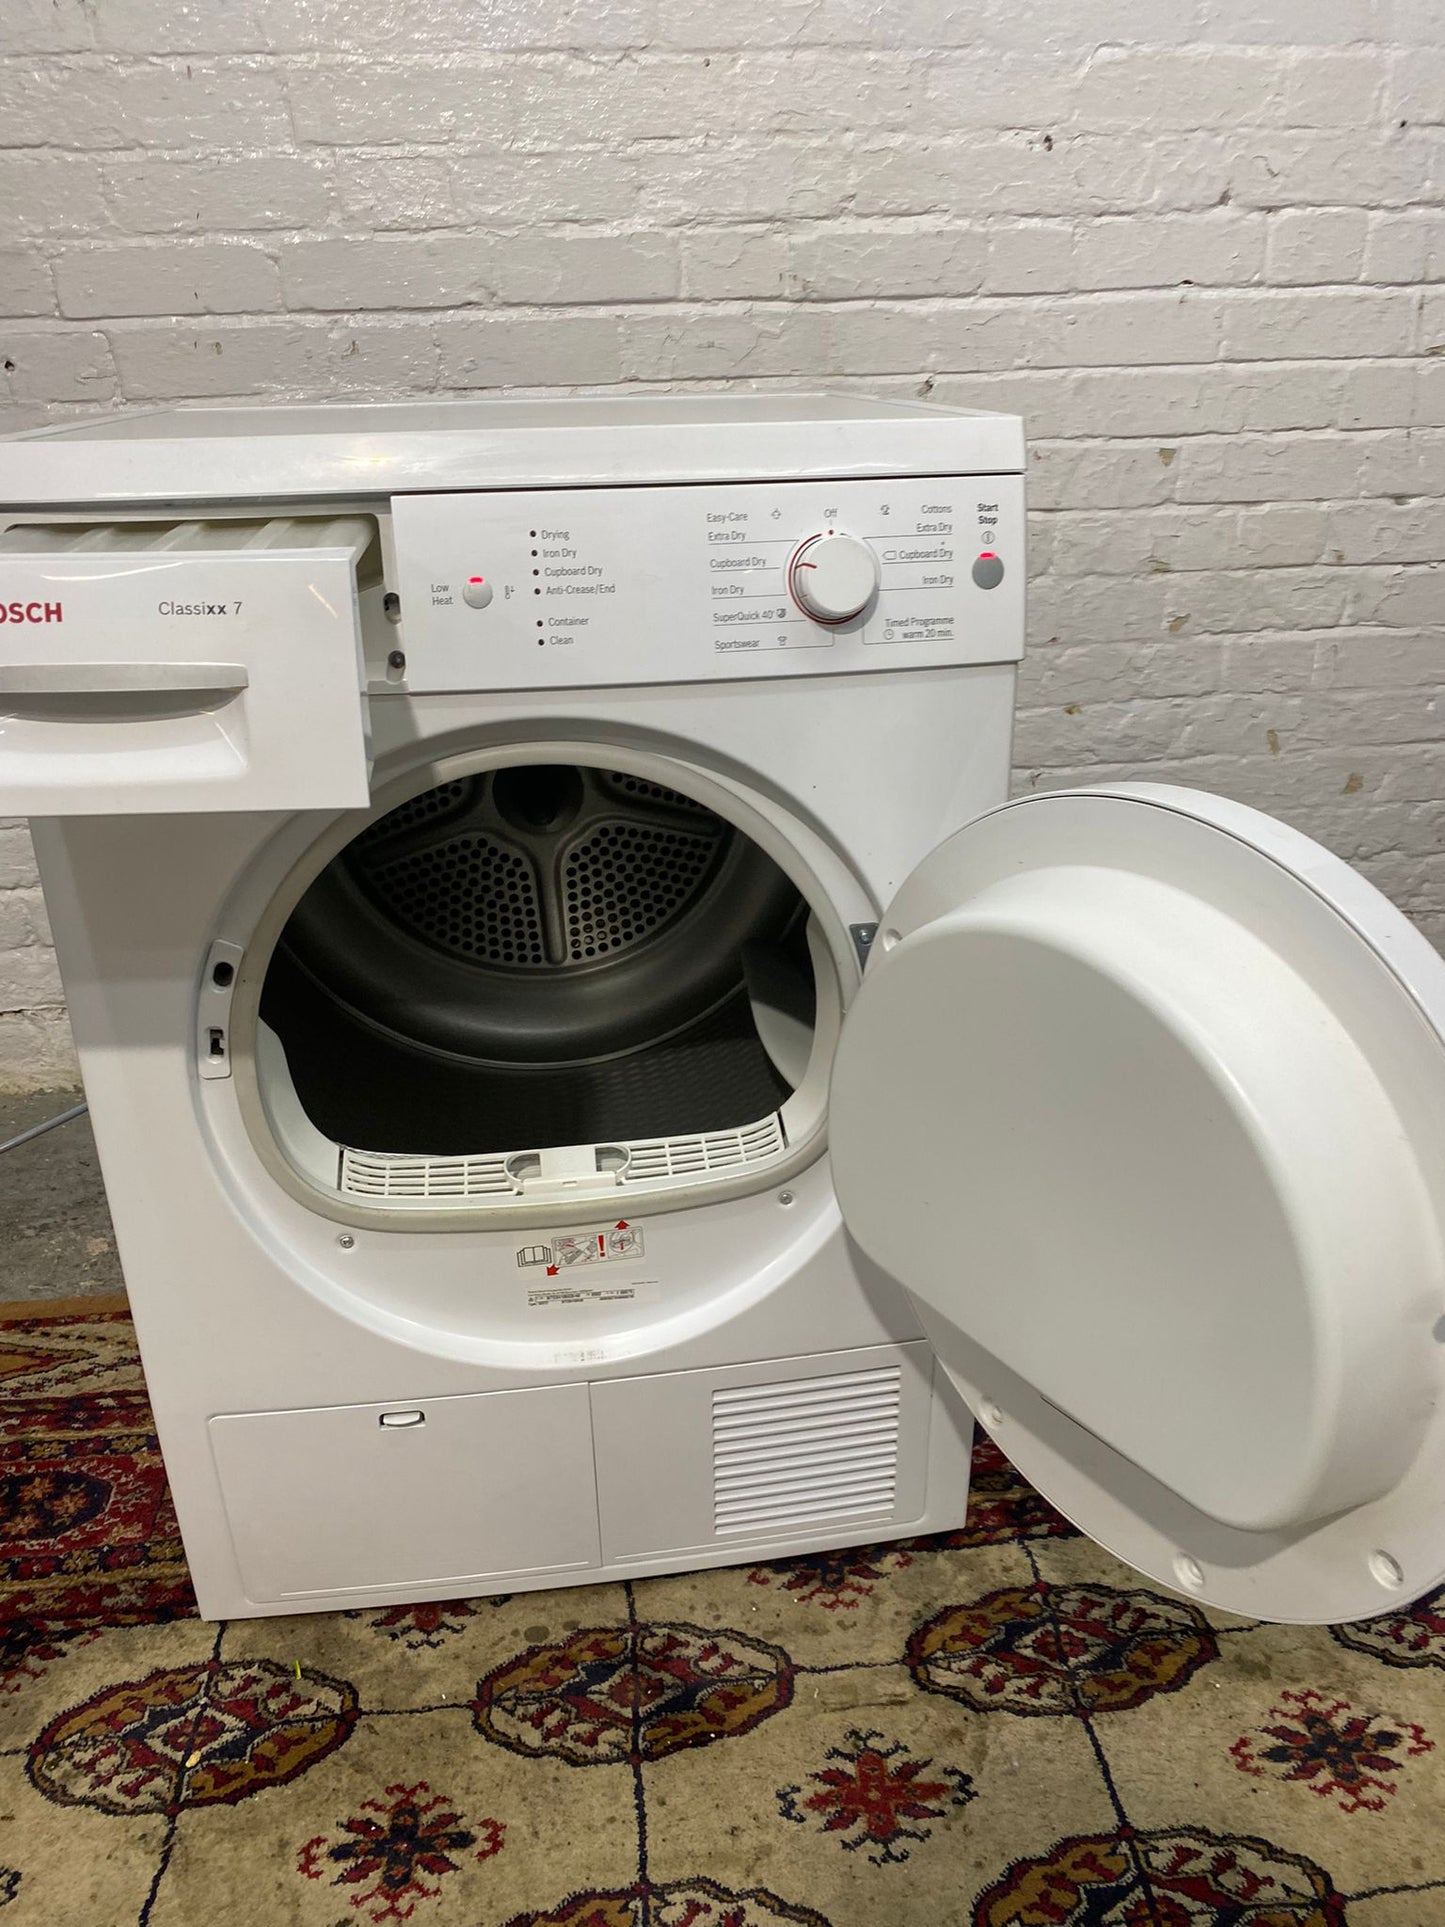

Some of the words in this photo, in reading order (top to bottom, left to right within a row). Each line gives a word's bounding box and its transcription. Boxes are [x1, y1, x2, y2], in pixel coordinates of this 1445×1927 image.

[824, 508, 838, 518] Off
[921, 504, 953, 514] Cottons
[976, 503, 999, 512] Start
[706, 512, 748, 524] Easy-Care
[978, 515, 998, 526] Stop
[916, 523, 938, 533] Extra
[938, 522, 953, 533] Dry
[541, 529, 570, 541] Drying
[708, 531, 731, 542] Extra
[731, 530, 746, 542] Dry
[542, 548, 560, 559] Iron
[561, 547, 577, 560] Dry
[899, 549, 939, 560] Cupboard
[939, 549, 953, 559] Dry
[709, 557, 751, 569] Cupboard
[751, 556, 767, 568] Dry
[544, 566, 586, 578] Cupboard
[587, 565, 603, 577] Dry
[923, 575, 939, 585] Iron
[939, 574, 954, 585] Dry
[430, 583, 449, 594] Low
[545, 583, 616, 596] Anti-Crease/End
[711, 585, 729, 595] Iron
[729, 584, 744, 595] Dry
[432, 595, 454, 606] Heat
[158, 601, 227, 616] Classixx
[233, 601, 243, 615] 7
[548, 616, 589, 627] Container
[712, 610, 760, 623] SuperQuick
[885, 617, 909, 628] Timed
[910, 616, 955, 628] Programme
[902, 630, 924, 639] warm
[925, 629, 936, 638] 20
[937, 628, 954, 638] min.
[549, 635, 574, 646] Clean
[714, 639, 760, 651] Sportswear
